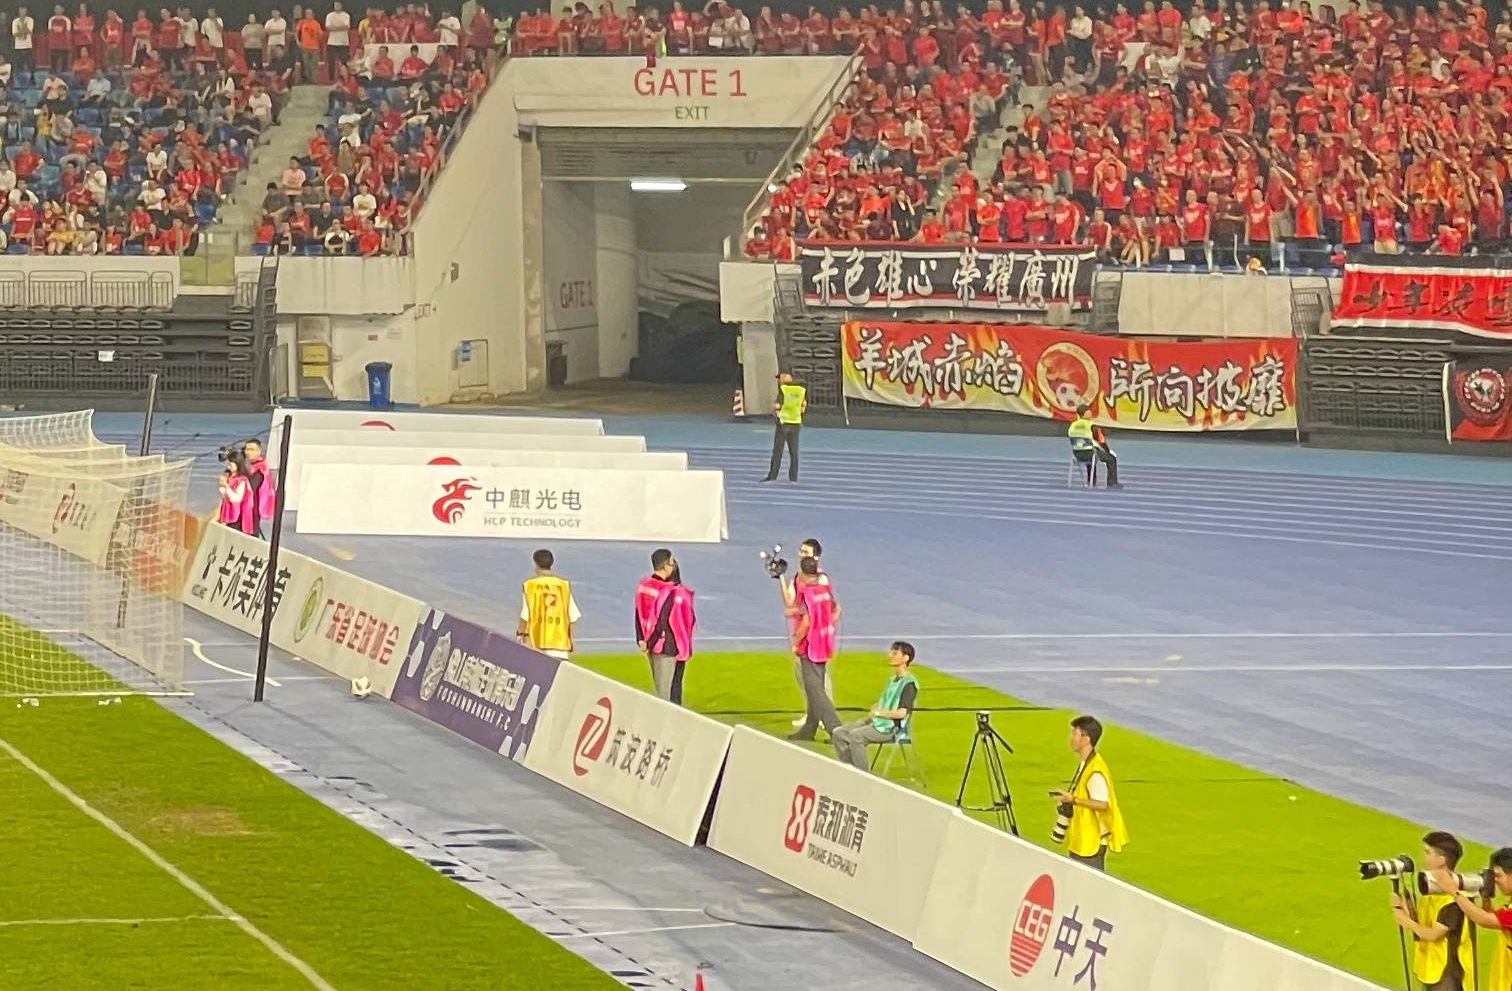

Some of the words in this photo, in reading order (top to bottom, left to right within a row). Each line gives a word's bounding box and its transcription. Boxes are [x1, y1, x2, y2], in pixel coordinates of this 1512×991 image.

[633, 67, 718, 98] GATE
[728, 68, 747, 98] 1
[674, 105, 710, 121] EXIT
[854, 325, 1024, 397] 羊城赤焰
[1105, 352, 1286, 422] 所向披靡
[485, 487, 583, 512] 中麒光电
[510, 516, 582, 529] TECHNOLOGY
[1014, 899, 1053, 943] CEG
[1053, 904, 1114, 991] 中天
